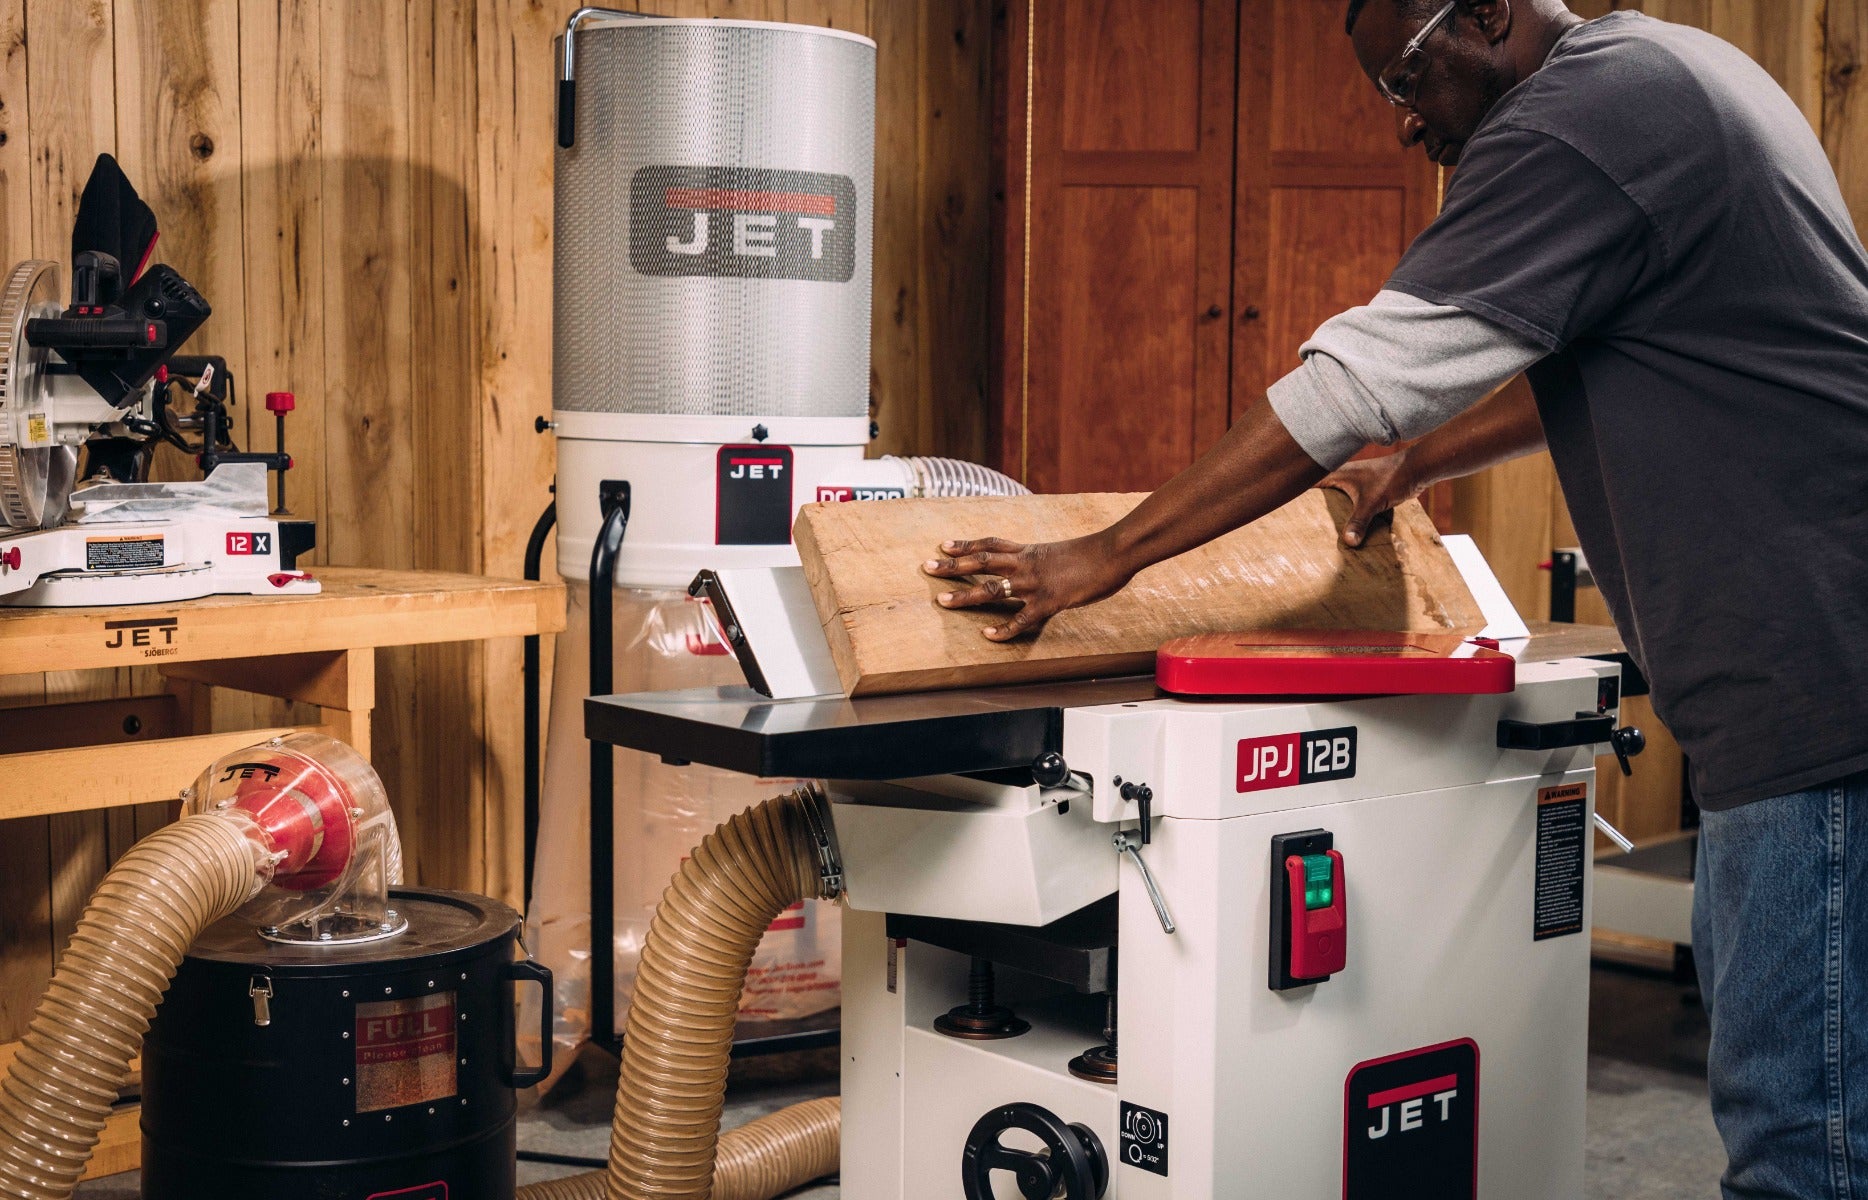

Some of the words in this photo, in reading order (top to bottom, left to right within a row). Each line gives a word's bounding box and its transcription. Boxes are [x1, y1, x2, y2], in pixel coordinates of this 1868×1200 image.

[666, 213, 835, 259] JET
[730, 464, 783, 479] JET
[231, 536, 248, 551] 12
[256, 536, 267, 551] X
[105, 627, 178, 648] JET
[144, 647, 178, 658] SJÖBERGS
[1244, 743, 1294, 782] JPJ
[1306, 737, 1350, 774] 12B
[219, 768, 278, 782] JET
[1551, 787, 1580, 798] WARNING
[367, 1013, 437, 1040] FULL
[1368, 1089, 1457, 1139] JET
[1157, 1142, 1165, 1150] UP
